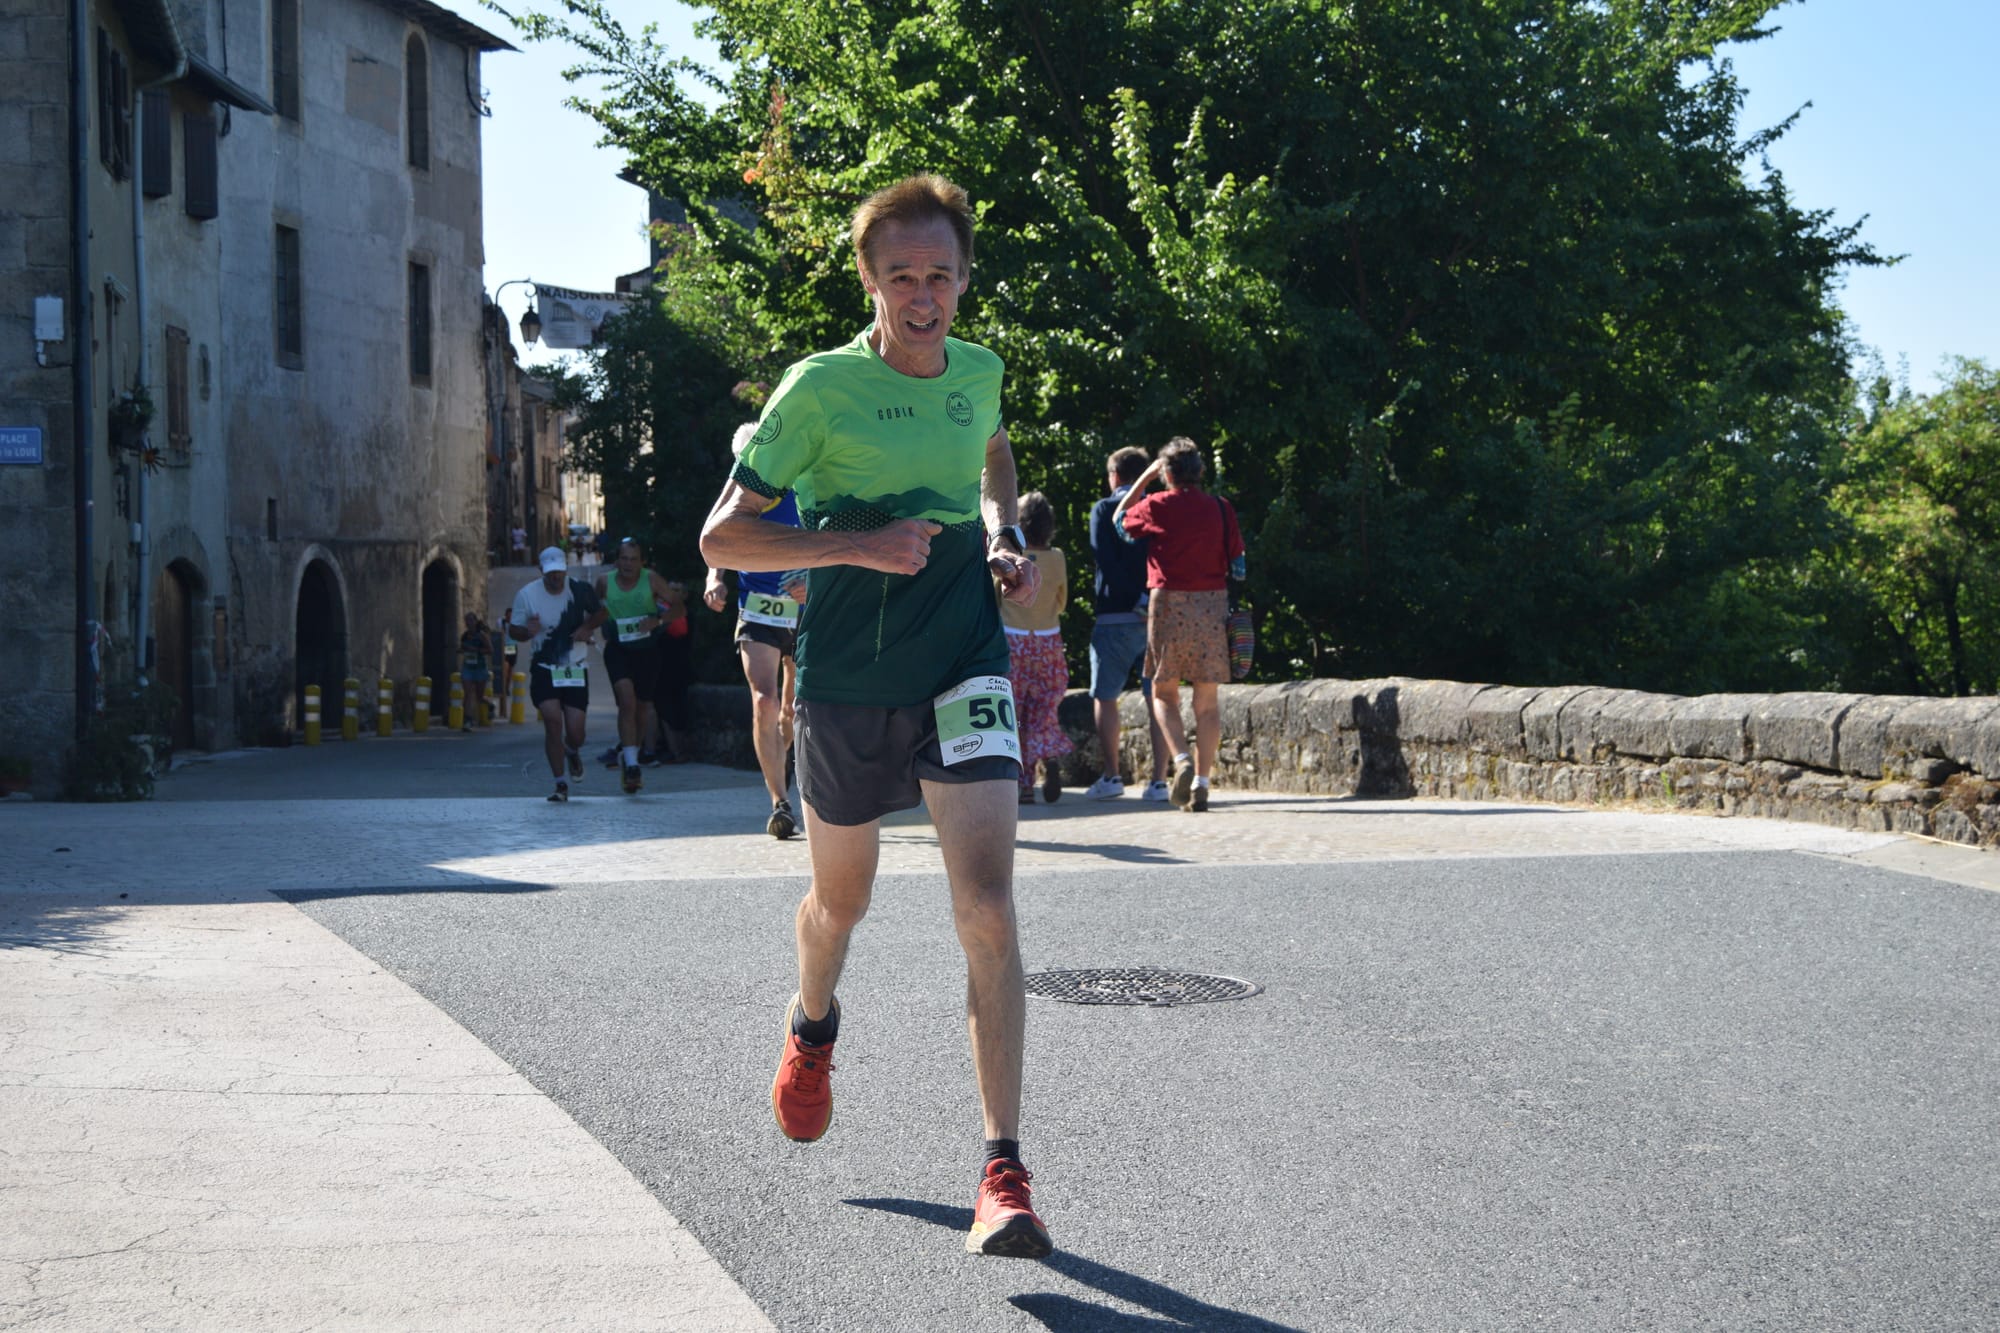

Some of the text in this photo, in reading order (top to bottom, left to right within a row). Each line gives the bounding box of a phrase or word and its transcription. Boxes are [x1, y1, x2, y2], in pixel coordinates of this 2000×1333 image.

[540, 286, 601, 301] MAISON
[877, 406, 914, 420] GOBIK
[0, 434, 27, 444] PLACE
[15, 448, 36, 456] LOUE
[759, 599, 784, 616] 20
[969, 697, 1015, 732] 50
[953, 740, 979, 752] BFP
